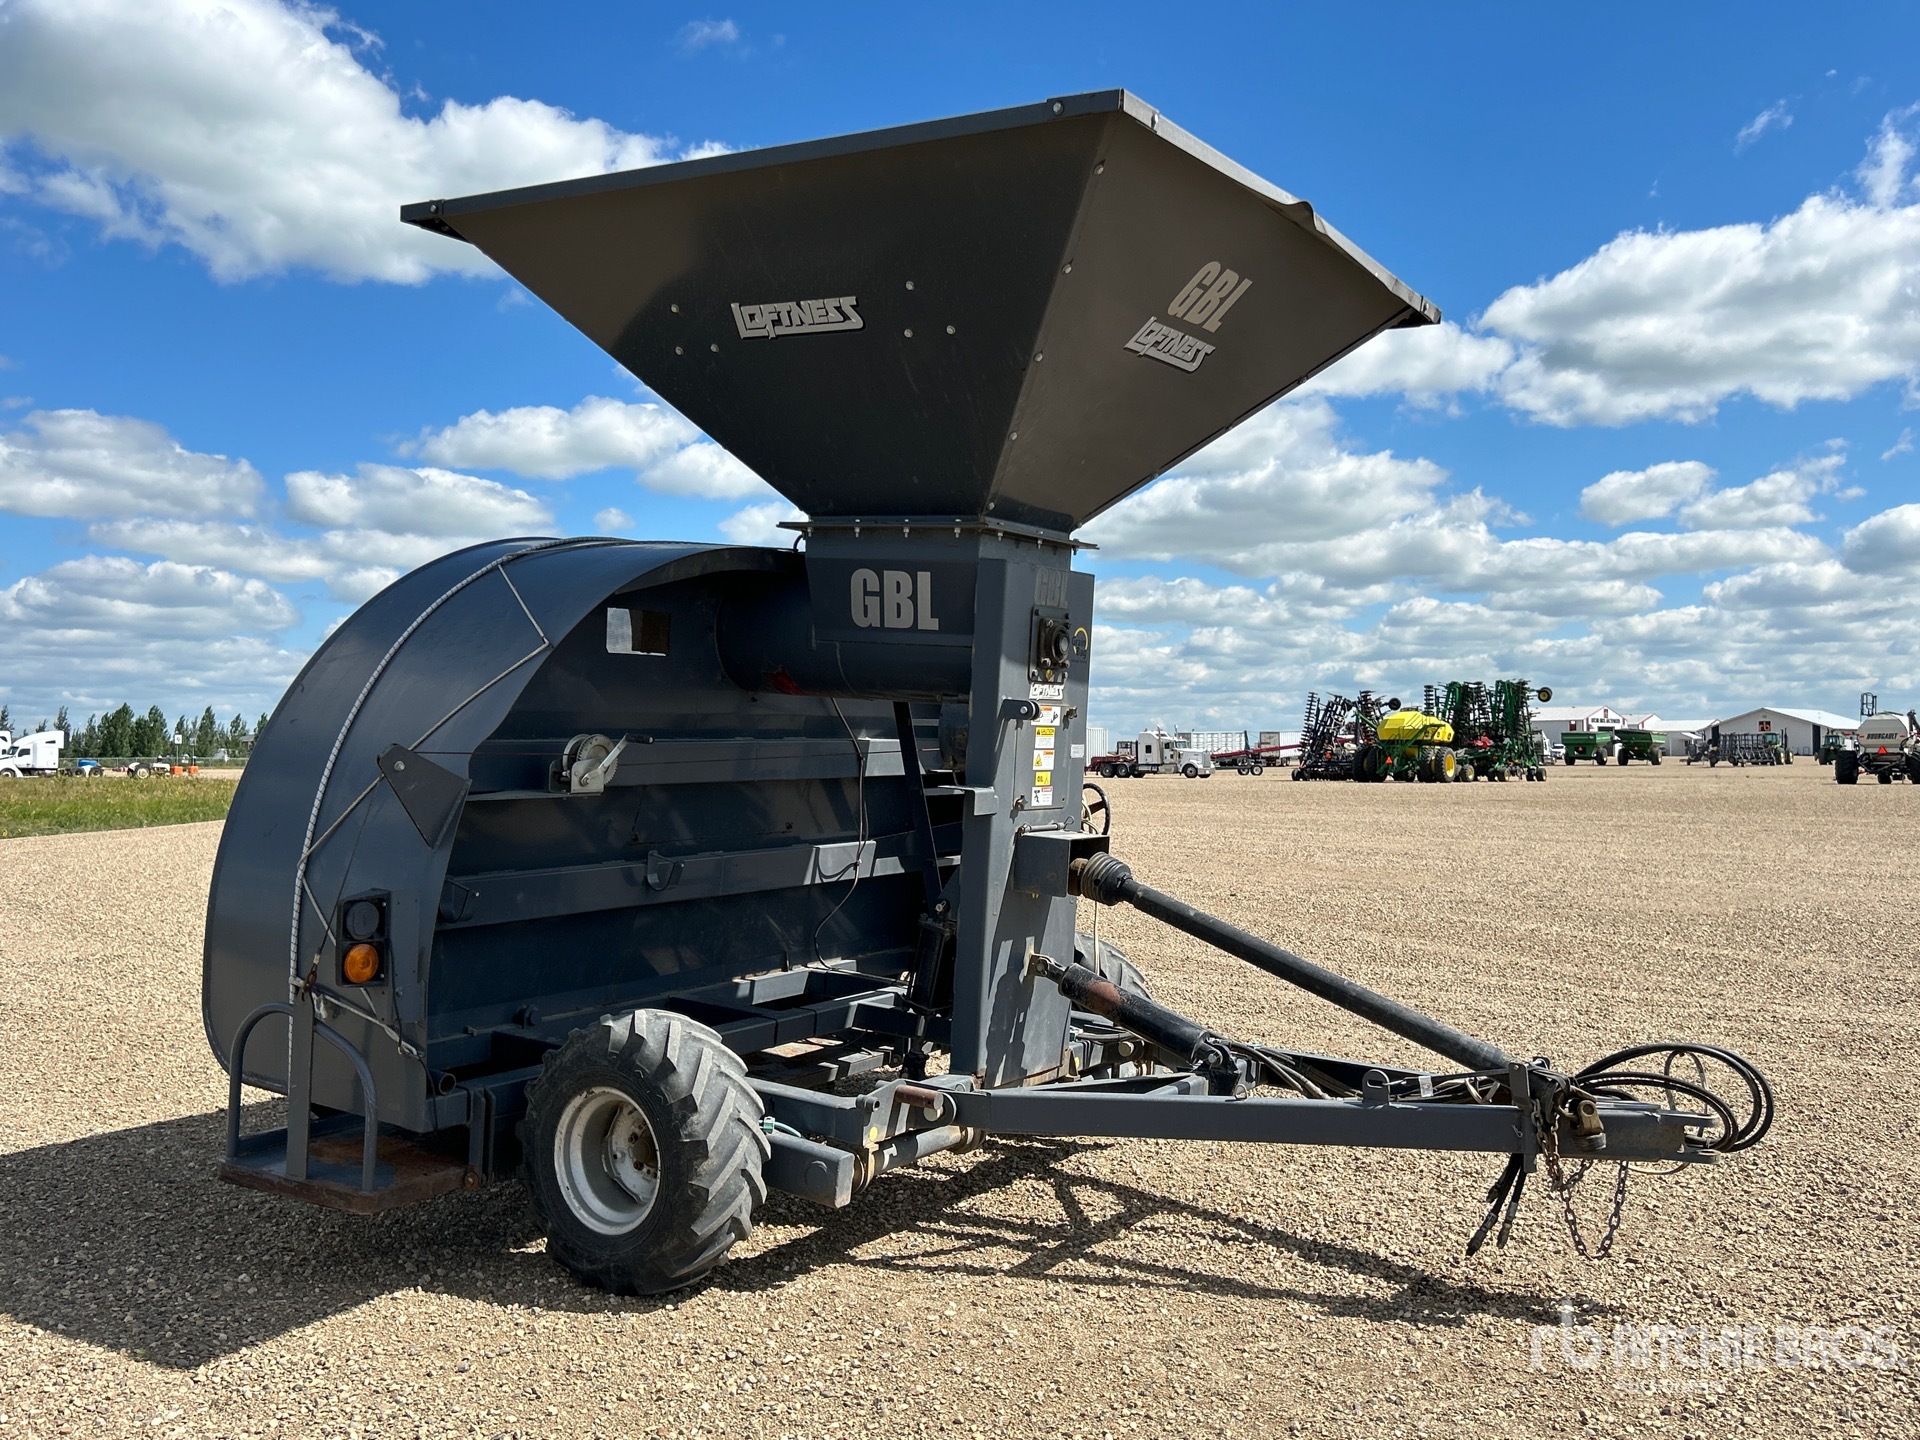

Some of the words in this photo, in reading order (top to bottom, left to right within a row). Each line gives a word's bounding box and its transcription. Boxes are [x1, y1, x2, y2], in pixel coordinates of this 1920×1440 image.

[731, 296, 865, 340] LOFTNESS
[1167, 261, 1253, 333] GBL
[1123, 316, 1216, 372] LOFTNESS
[850, 568, 939, 631] GBL
[1034, 567, 1068, 609] GBL
